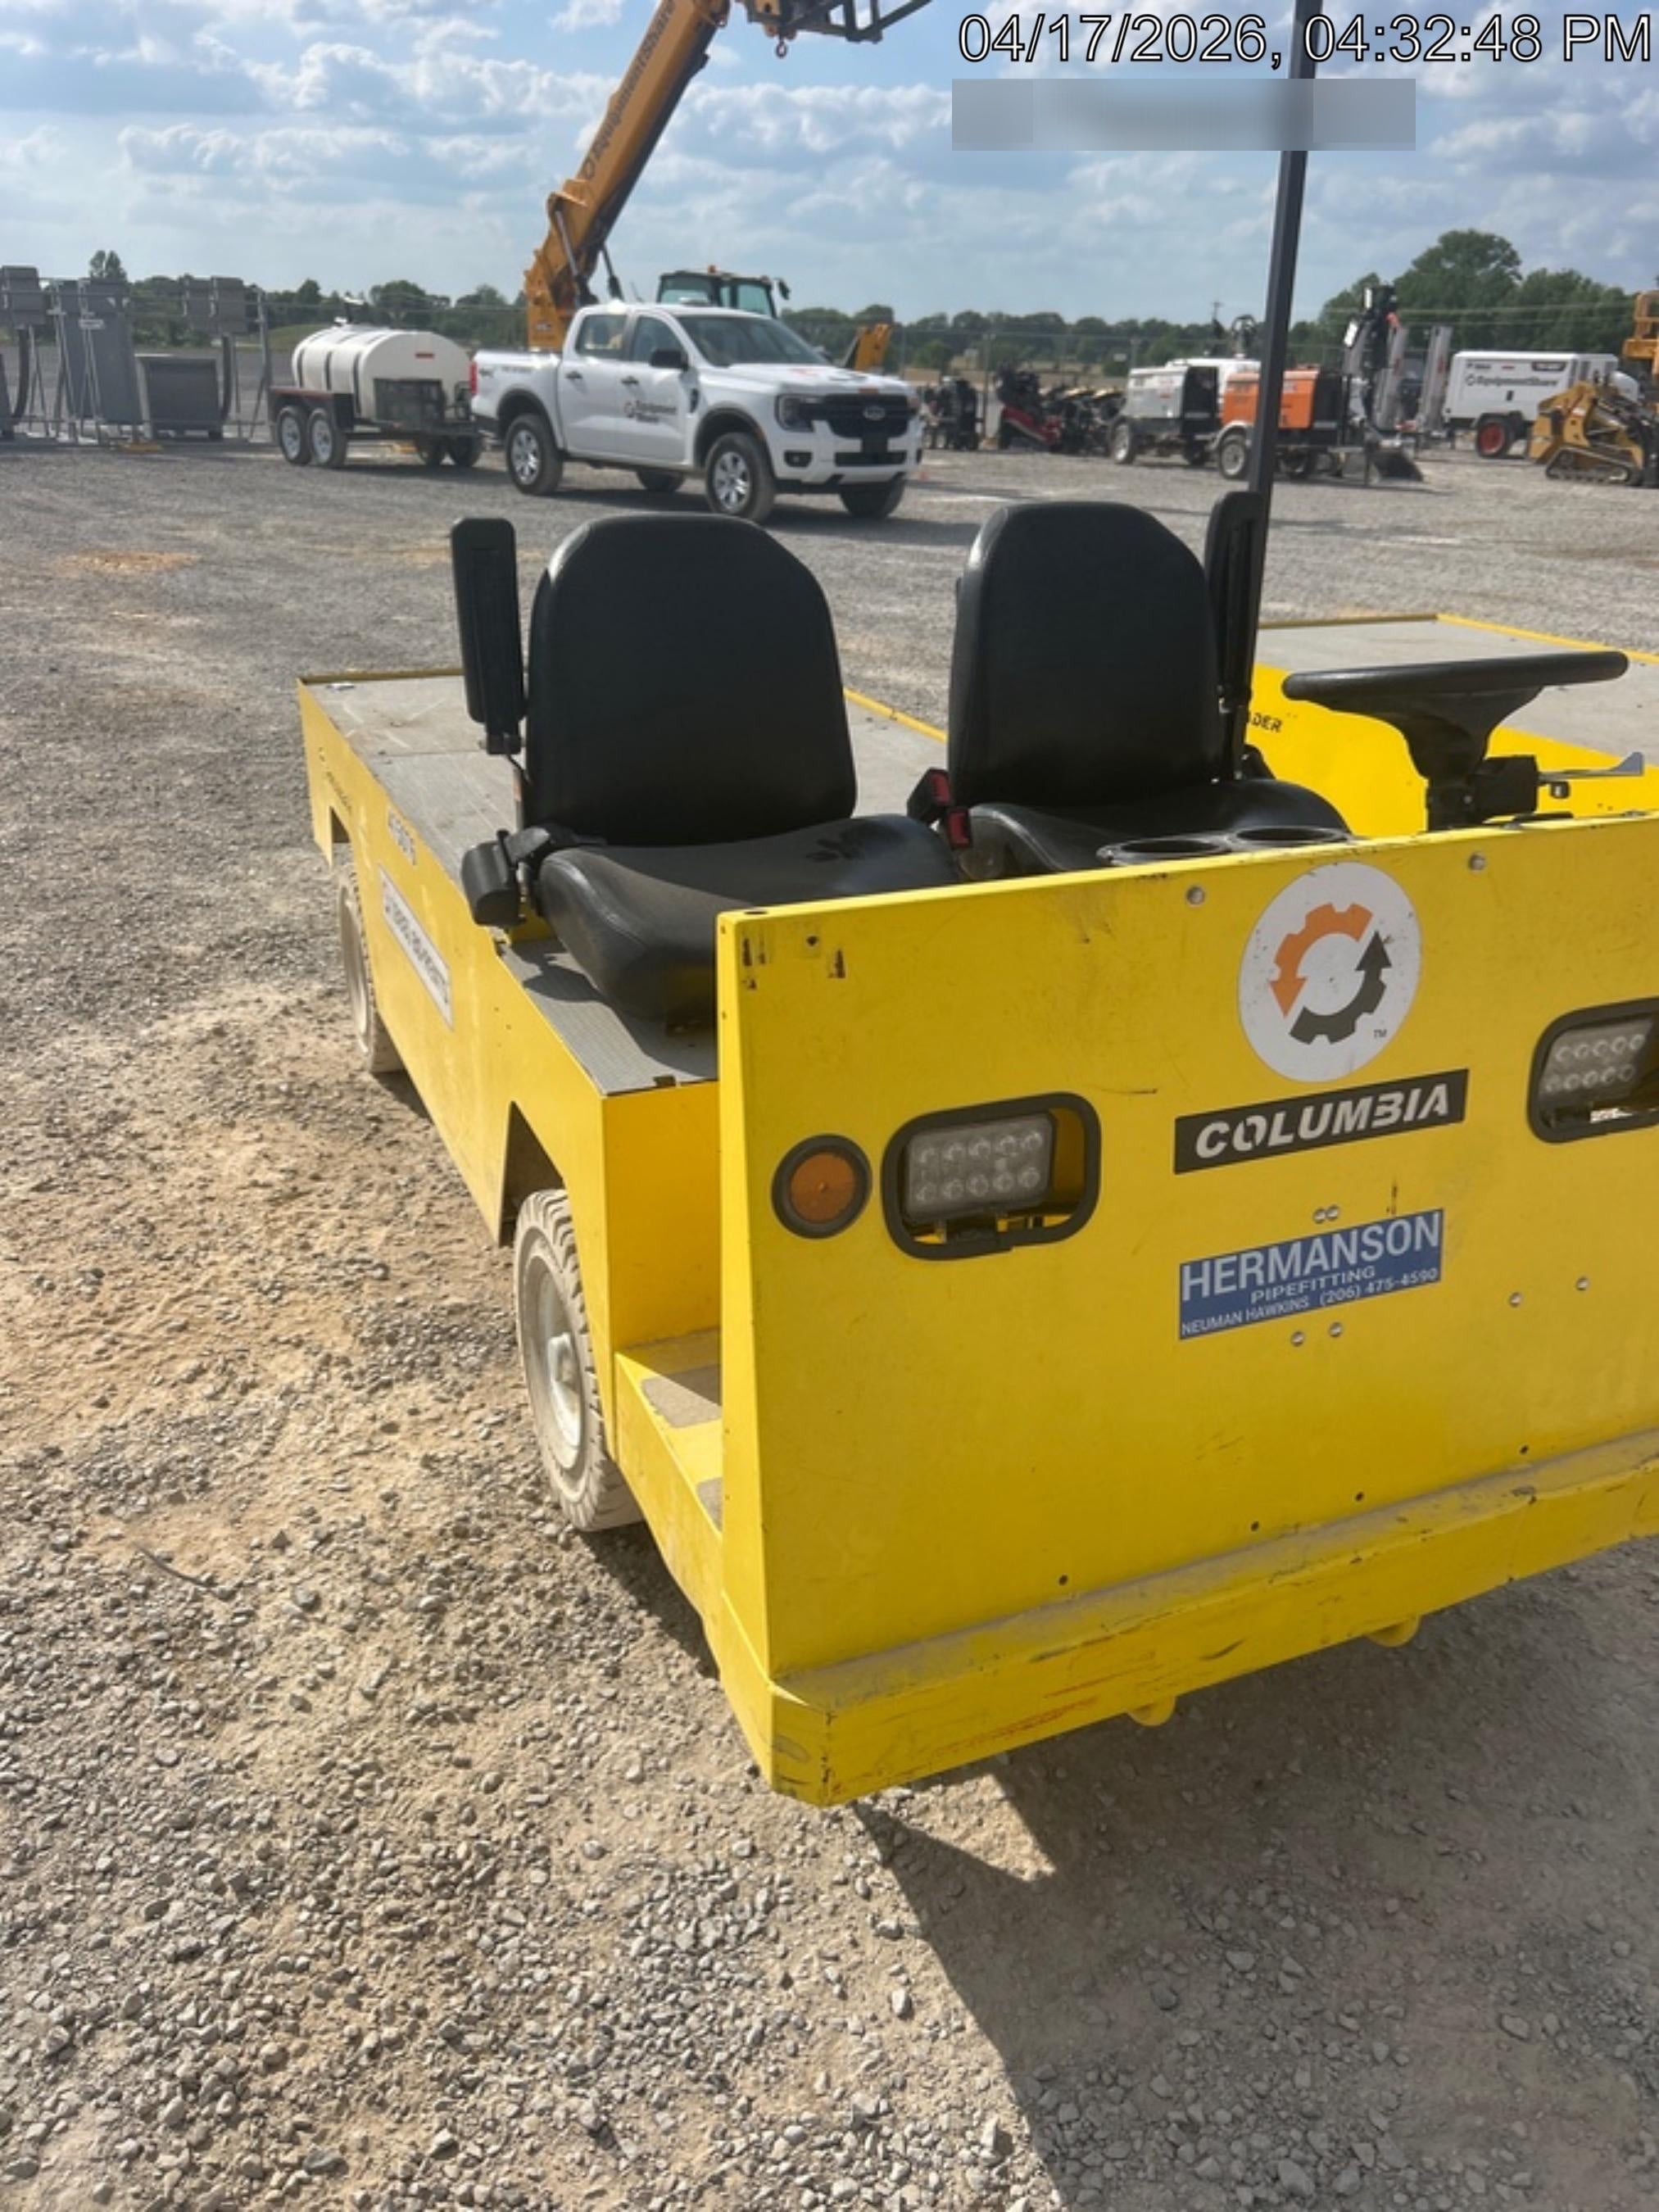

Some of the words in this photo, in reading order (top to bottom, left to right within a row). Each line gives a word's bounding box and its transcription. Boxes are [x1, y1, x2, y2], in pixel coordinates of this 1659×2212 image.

[1195, 1083, 1448, 1159] COLUMBIA
[1182, 1213, 1439, 1301] HERMANSON
[1250, 1265, 1376, 1304] PIPEFITTING
[1181, 1312, 1243, 1336] NEUMAN
[1245, 1297, 1310, 1321] HAWKINS
[1320, 1284, 1361, 1308] (206)
